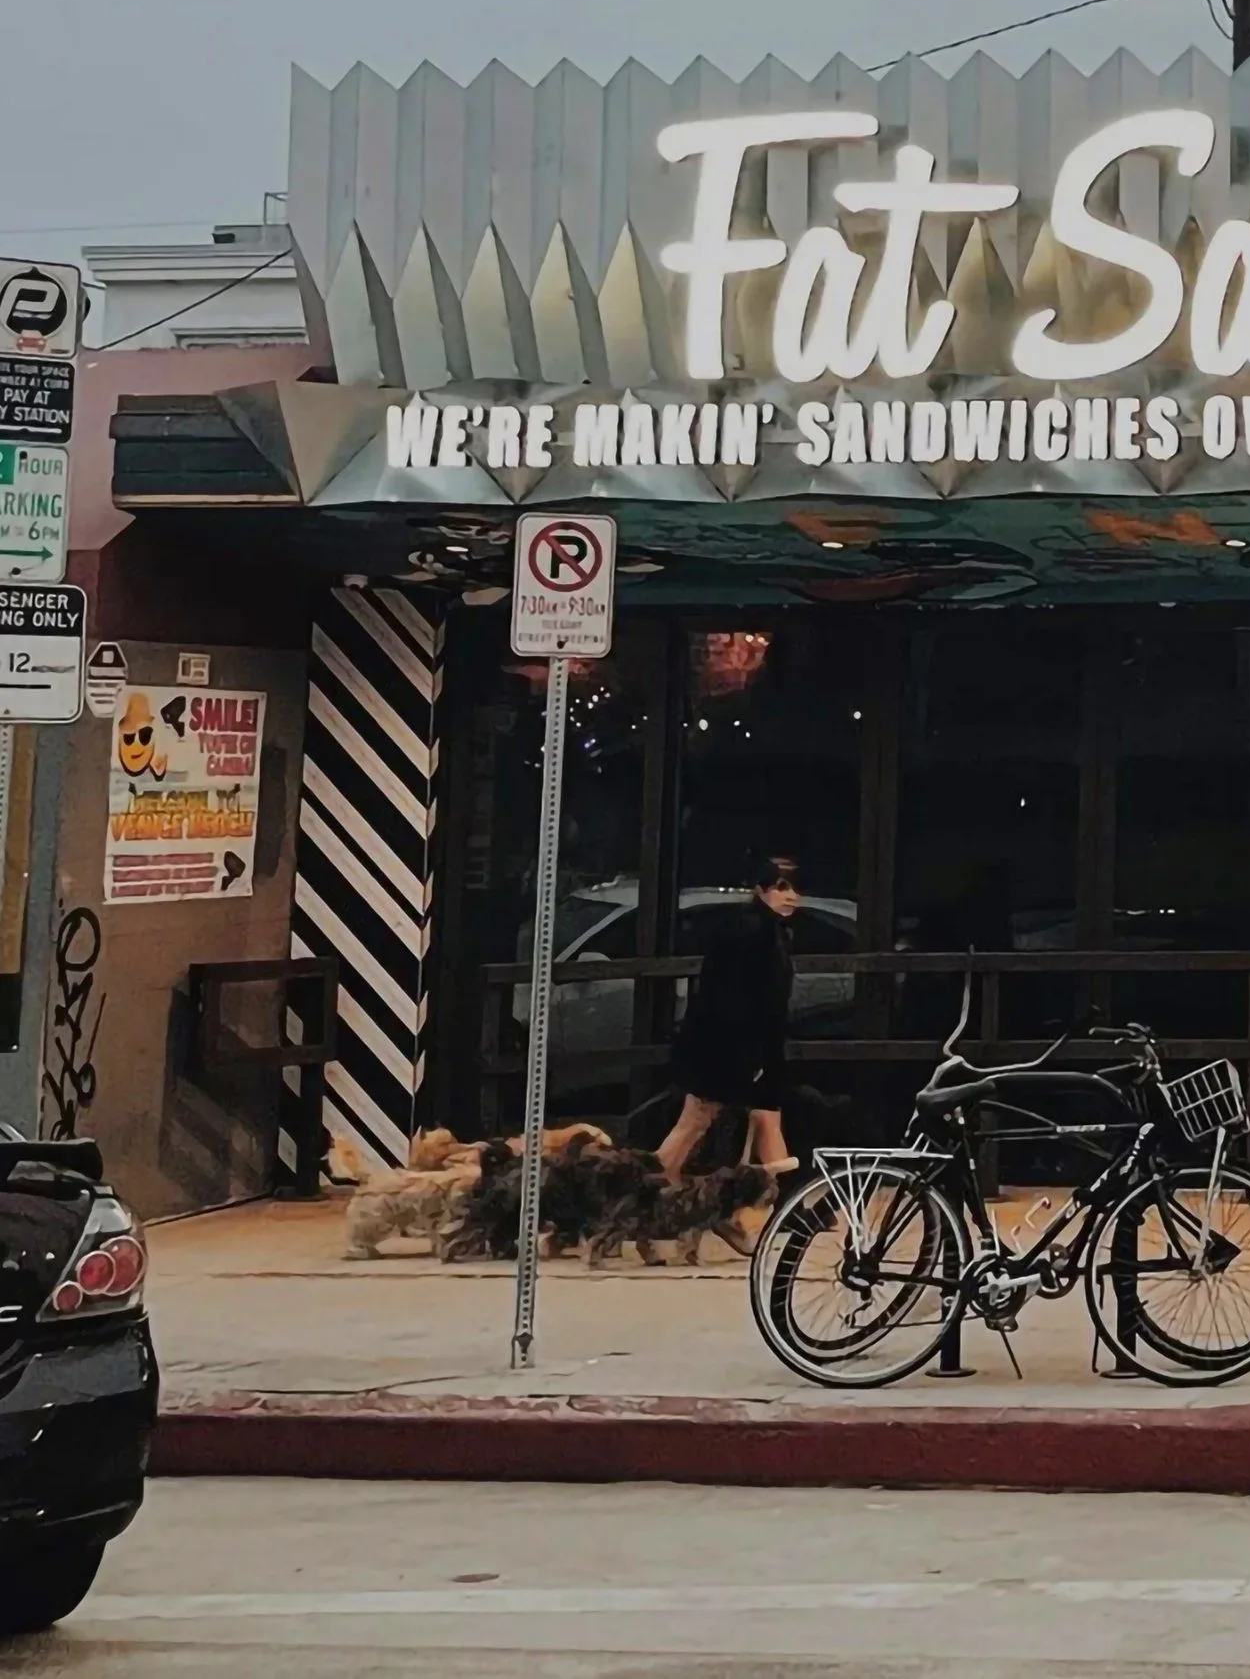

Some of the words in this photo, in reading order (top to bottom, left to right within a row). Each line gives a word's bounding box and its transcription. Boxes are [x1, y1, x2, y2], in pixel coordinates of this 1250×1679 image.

[656, 110, 1020, 382] Fat
[4, 387, 29, 403] PAY
[33, 390, 51, 405] AT
[13, 406, 70, 423] STATION
[386, 404, 555, 467] WE'RE
[573, 402, 774, 466] MAKIN'
[796, 395, 1181, 466] SANDWICHES
[19, 458, 63, 475] HOUR
[0, 492, 62, 518] RKING
[33, 611, 79, 628] ONLY
